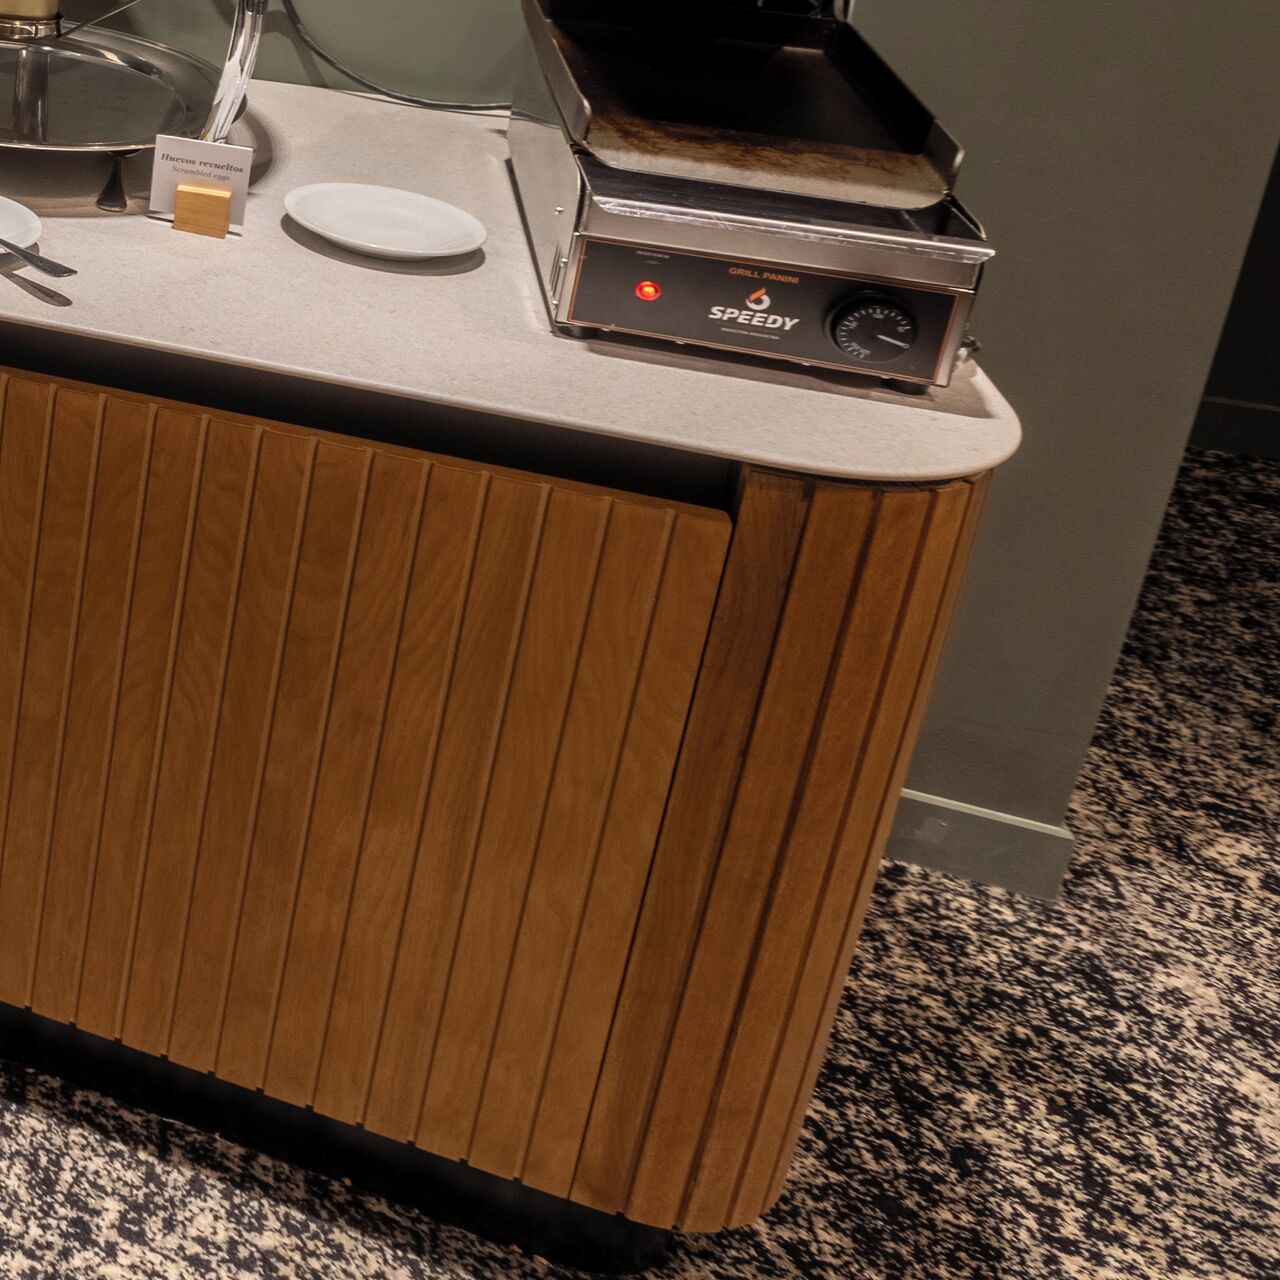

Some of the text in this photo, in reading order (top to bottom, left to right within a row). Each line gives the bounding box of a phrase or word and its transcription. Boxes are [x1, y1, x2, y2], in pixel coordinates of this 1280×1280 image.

[161, 152, 244, 173] Huevos revueltos
[171, 166, 230, 182] Scrambled eggs
[729, 267, 800, 284] GRILL PANINI
[708, 305, 800, 331] SPEEDY
